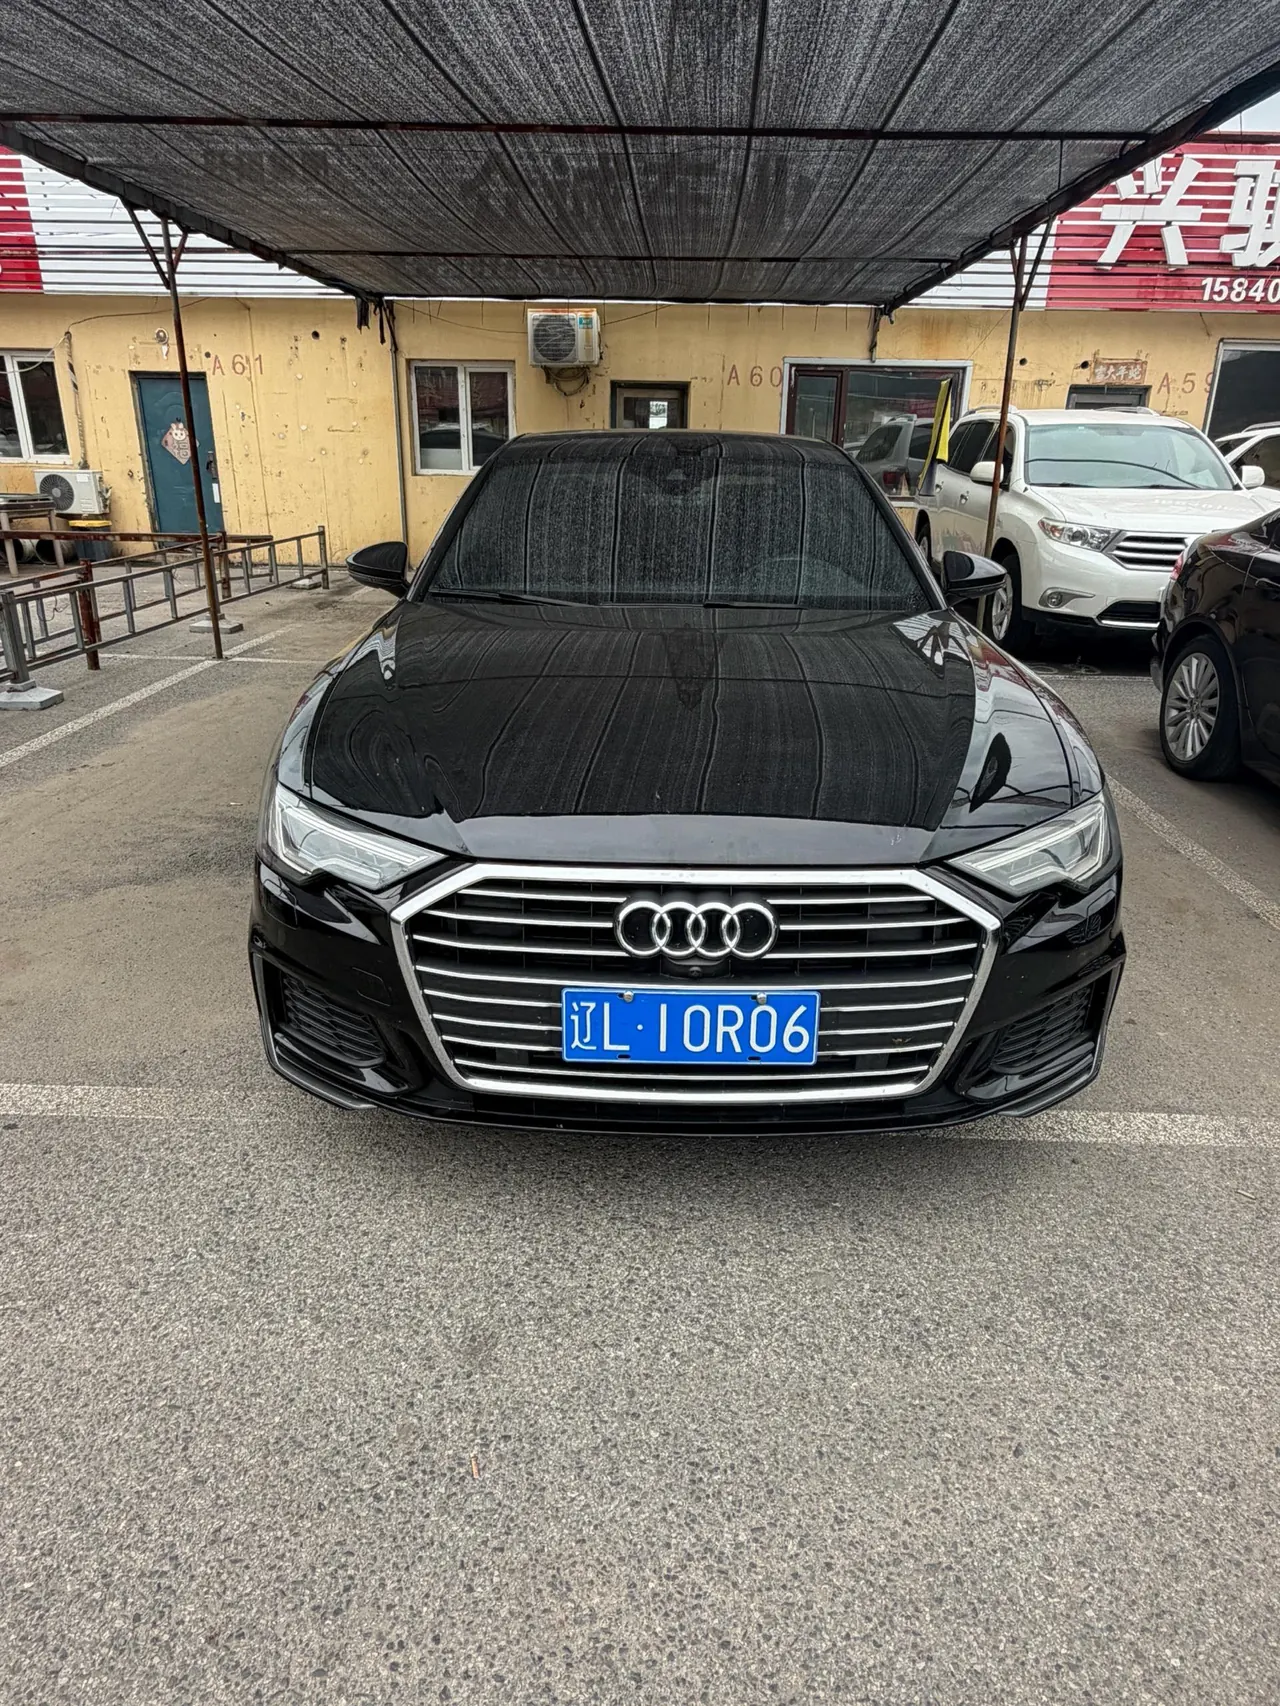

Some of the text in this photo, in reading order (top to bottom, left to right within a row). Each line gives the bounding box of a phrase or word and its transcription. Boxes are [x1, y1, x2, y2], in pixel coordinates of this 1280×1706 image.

[1201, 277, 1280, 303] 15840
[212, 354, 263, 376] A61
[727, 364, 782, 387] A60
